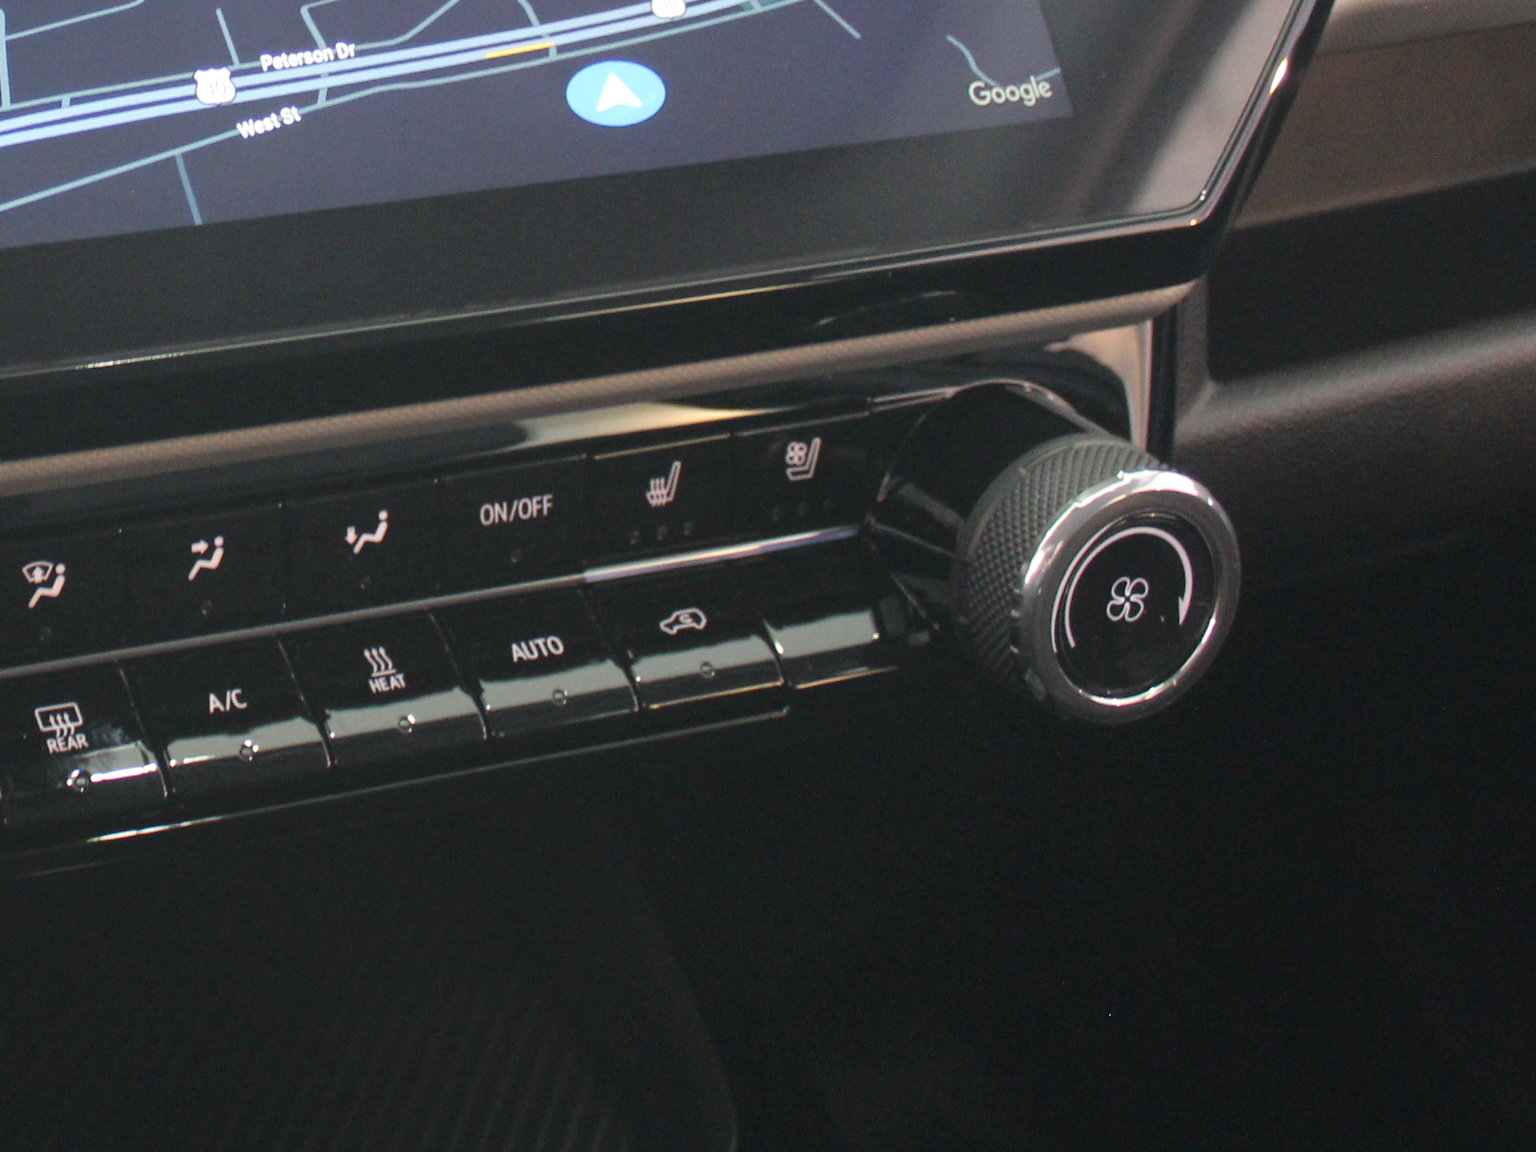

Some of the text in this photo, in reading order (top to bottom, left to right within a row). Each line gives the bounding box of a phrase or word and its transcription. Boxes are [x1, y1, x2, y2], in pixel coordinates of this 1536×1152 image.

[259, 42, 356, 72] Peterson Dr
[967, 75, 1053, 108] Google
[236, 106, 302, 140] West St
[479, 493, 555, 527] ON/OFF
[511, 635, 565, 663] AUTO
[368, 673, 407, 695] HEAT
[208, 688, 249, 715] A/C
[45, 733, 90, 754] REAR
